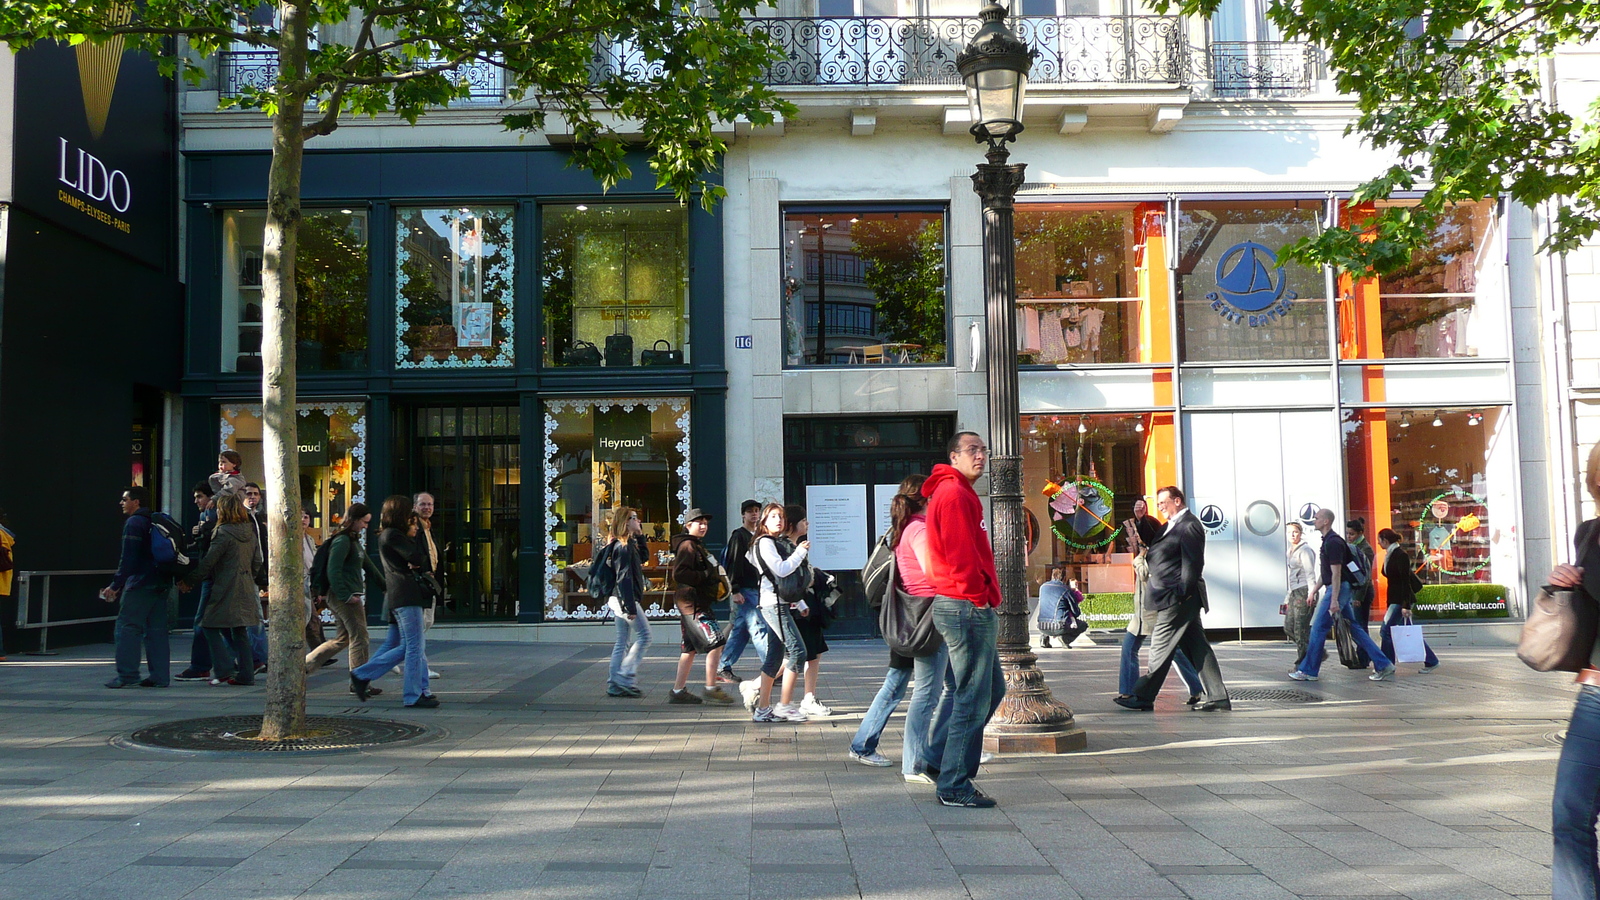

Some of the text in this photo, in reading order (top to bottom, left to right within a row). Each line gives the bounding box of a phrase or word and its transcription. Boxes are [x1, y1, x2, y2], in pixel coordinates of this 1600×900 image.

[59, 136, 131, 213] LIDO
[1206, 289, 1298, 328] PETIT BATEAU
[735, 337, 752, 348] 116
[296, 440, 321, 452] raud
[599, 435, 645, 450] Heyraud
[1416, 601, 1505, 612] www.petit-bateau.com
[1079, 612, 1136, 621] it-bateau.com
